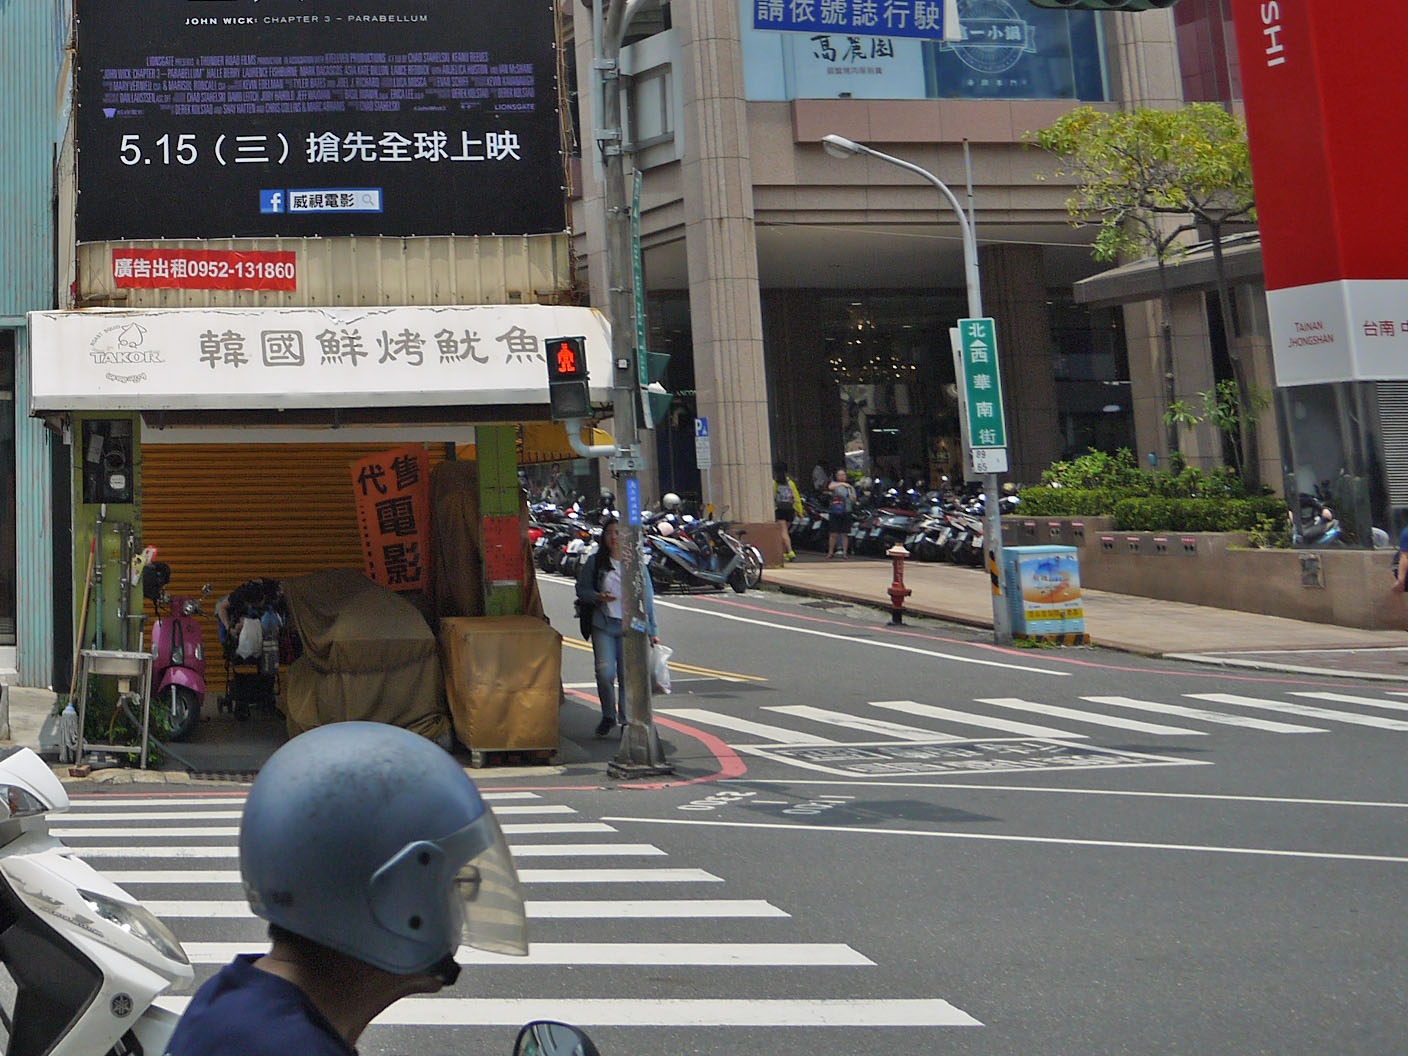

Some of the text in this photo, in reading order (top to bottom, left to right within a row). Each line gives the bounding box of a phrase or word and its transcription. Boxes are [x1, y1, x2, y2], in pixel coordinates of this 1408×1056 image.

[185, 17, 218, 26] JOHN
[263, 15, 319, 24] CHAPTER
[347, 14, 428, 23] PARABELLUM
[969, 322, 986, 339] 北
[199, 325, 546, 368] 韓國鮮烤魷魚
[970, 347, 997, 445] 西華南街
